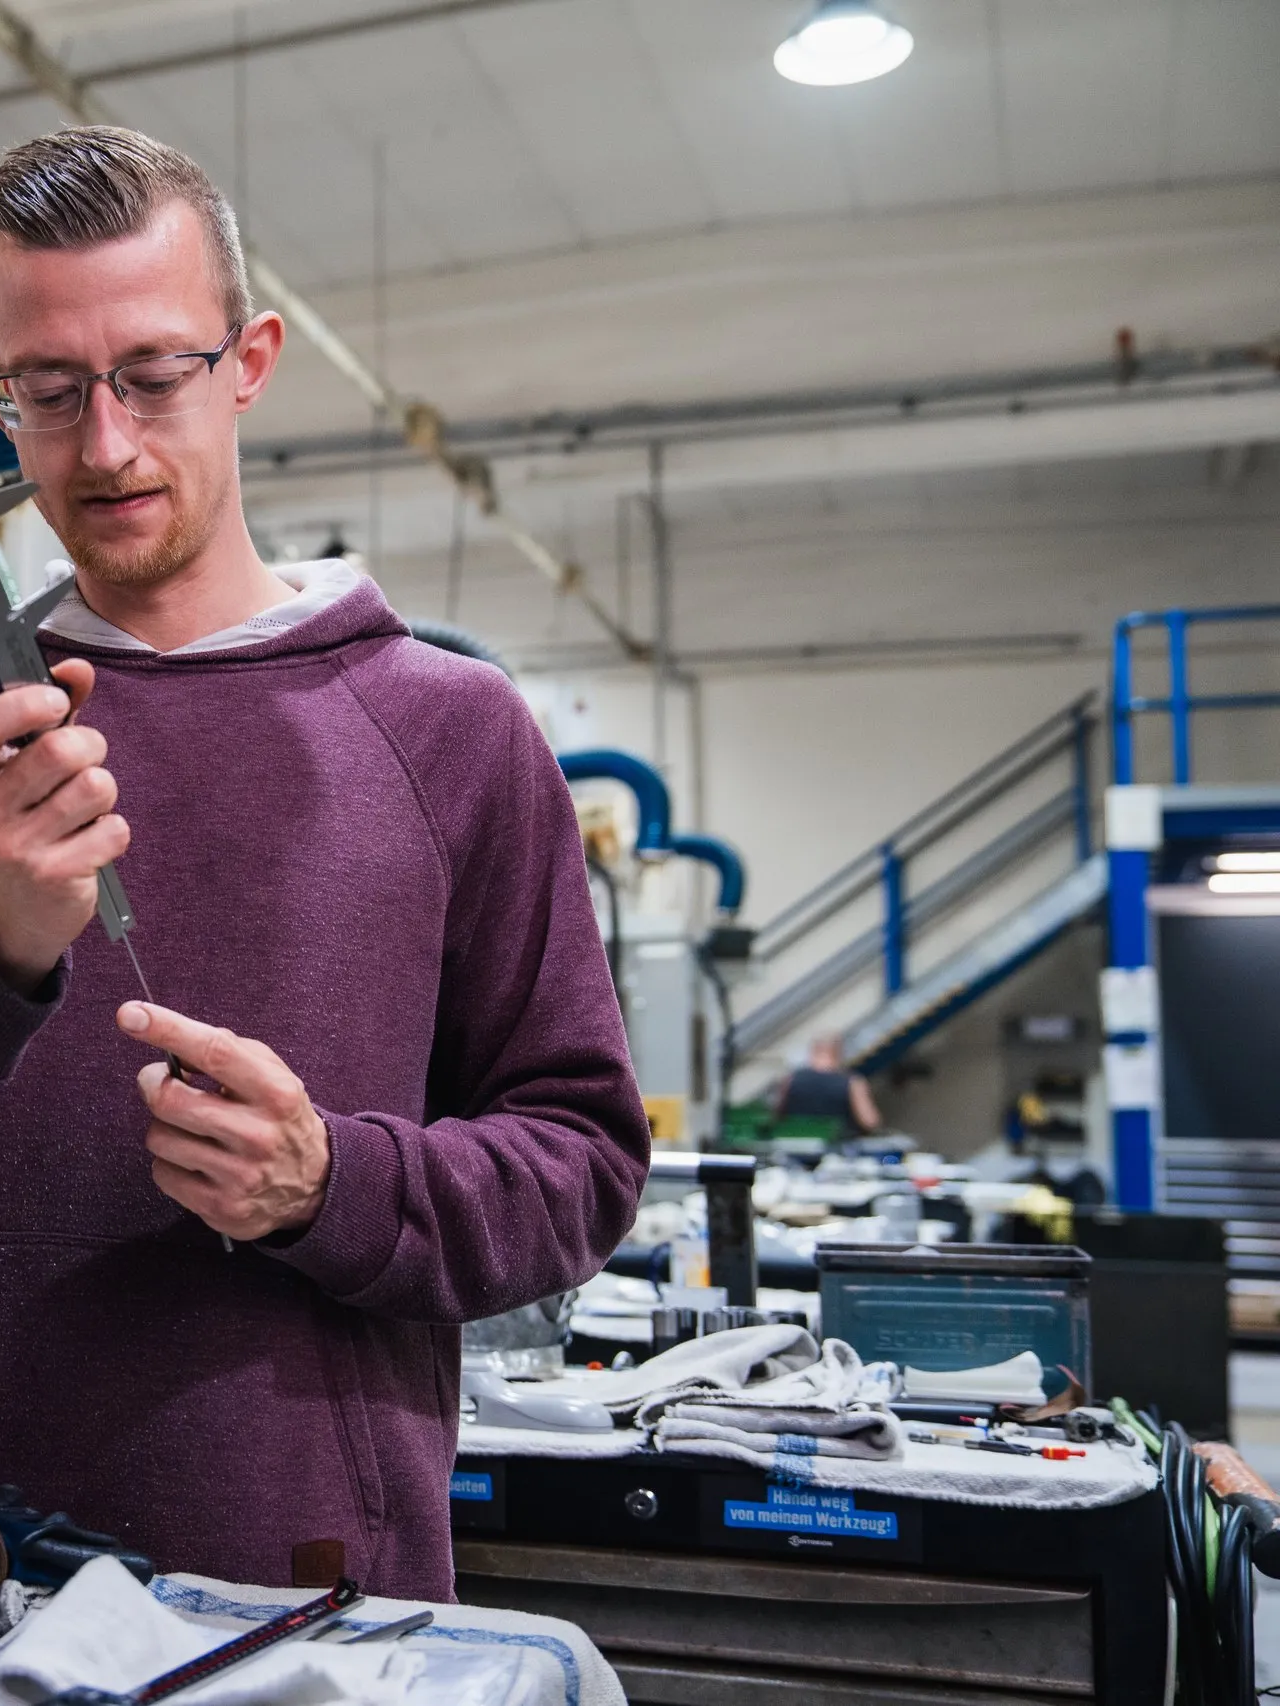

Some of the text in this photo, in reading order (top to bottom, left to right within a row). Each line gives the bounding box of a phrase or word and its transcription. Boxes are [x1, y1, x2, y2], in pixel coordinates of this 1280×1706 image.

[821, 1496, 850, 1512] weg
[730, 1508, 891, 1535] von meinem Werkzeug!
